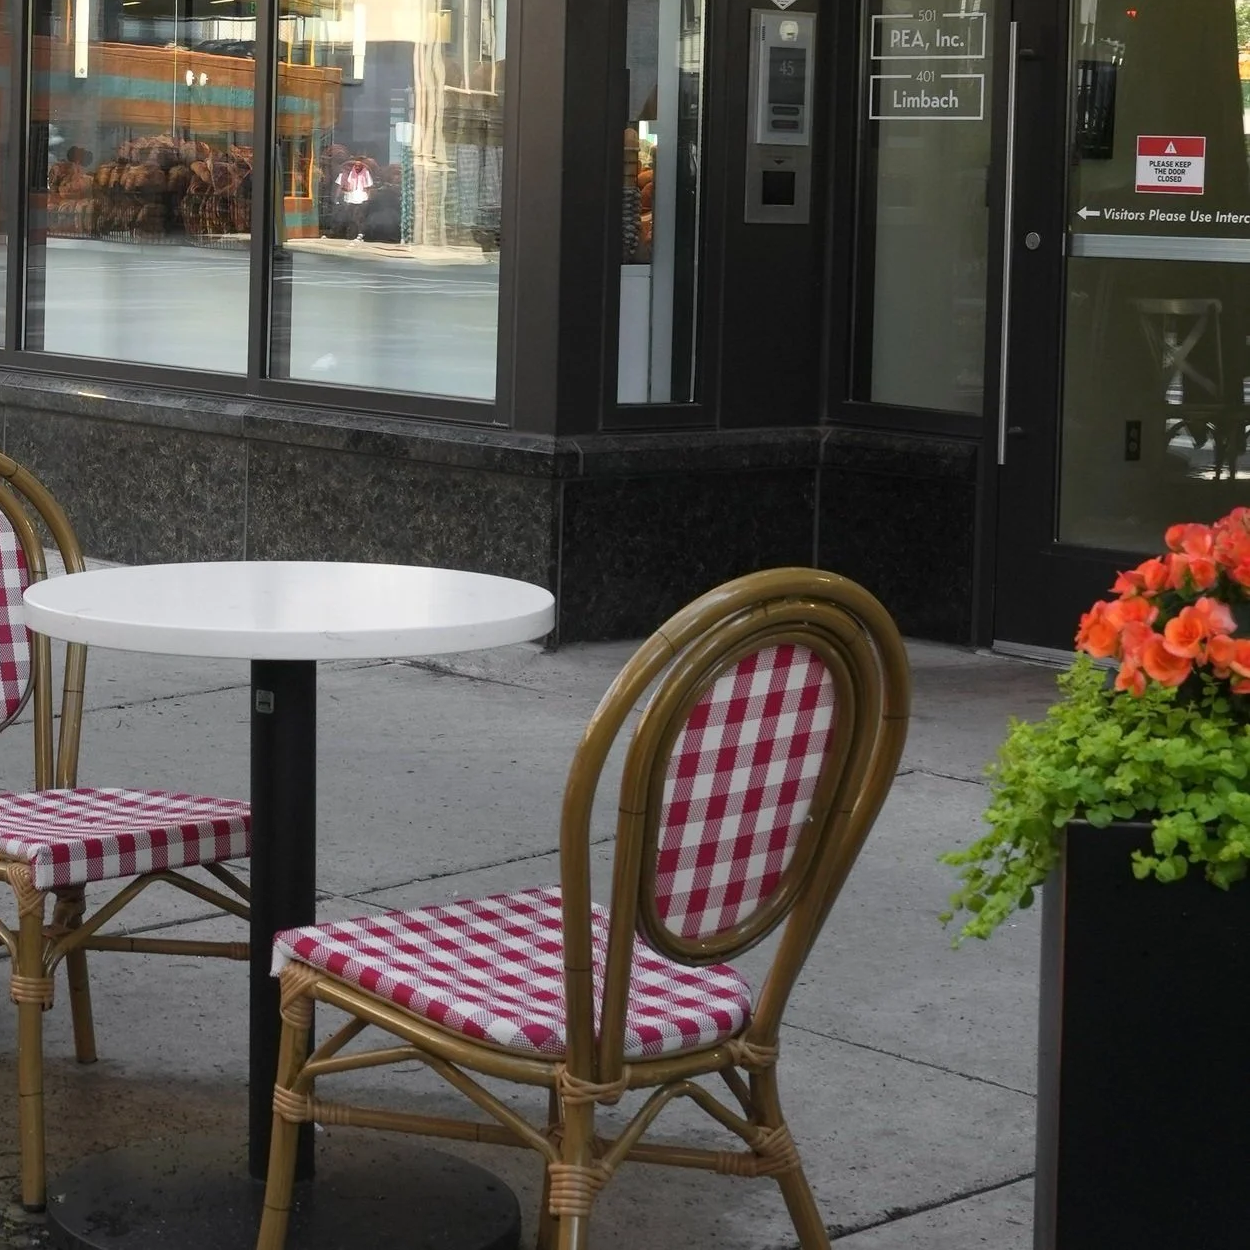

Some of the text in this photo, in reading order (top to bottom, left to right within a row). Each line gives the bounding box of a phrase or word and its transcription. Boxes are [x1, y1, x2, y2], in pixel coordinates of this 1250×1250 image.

[918, 10, 936, 22] 501
[890, 29, 965, 51] PEA, Inc.
[779, 60, 795, 76] 45
[916, 71, 935, 83] 401
[893, 89, 959, 108] Limbach
[1149, 160, 1174, 168] PLEASE
[1157, 175, 1182, 183] CLOSED
[1103, 208, 1250, 224] Visitors Please Use Interc
